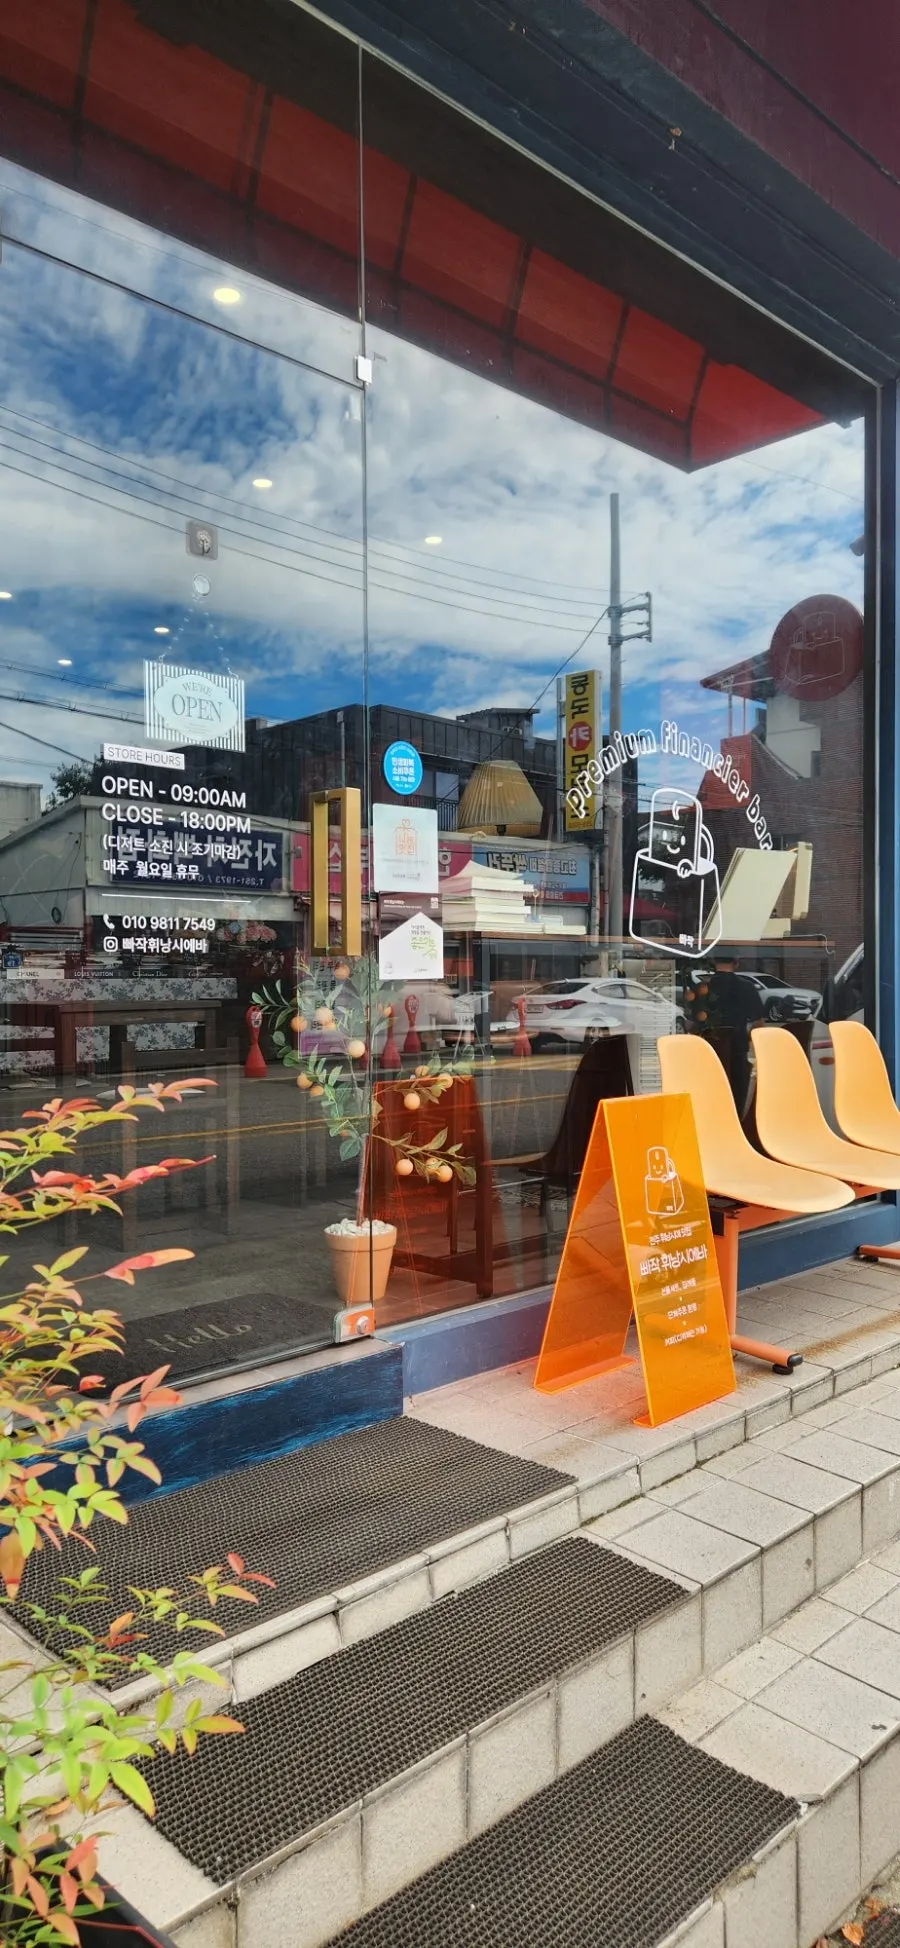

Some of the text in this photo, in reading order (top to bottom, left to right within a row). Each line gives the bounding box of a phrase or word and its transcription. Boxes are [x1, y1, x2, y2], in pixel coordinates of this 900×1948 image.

[182, 681, 213, 697] WE'RE
[171, 693, 223, 722] OPEN
[107, 746, 181, 767] STORE HOURS
[101, 775, 153, 798] OPEN
[170, 783, 246, 809] 09:00AM
[565, 720, 772, 851] premium financier bar
[101, 802, 164, 826] CLOSE
[180, 810, 251, 834] 18:00PM
[102, 834, 241, 860] (디저트 소진 시 조기마감)
[103, 858, 129, 876] 매주
[135, 860, 173, 877] 월요일
[176, 863, 200, 879] 휴무
[122, 915, 216, 931] 010 9811 7549
[122, 936, 208, 954] 빠작휘낭시에바
[640, 1244, 708, 1276] 빠작 휘낭시에바
[143, 1323, 253, 1353] Hello
